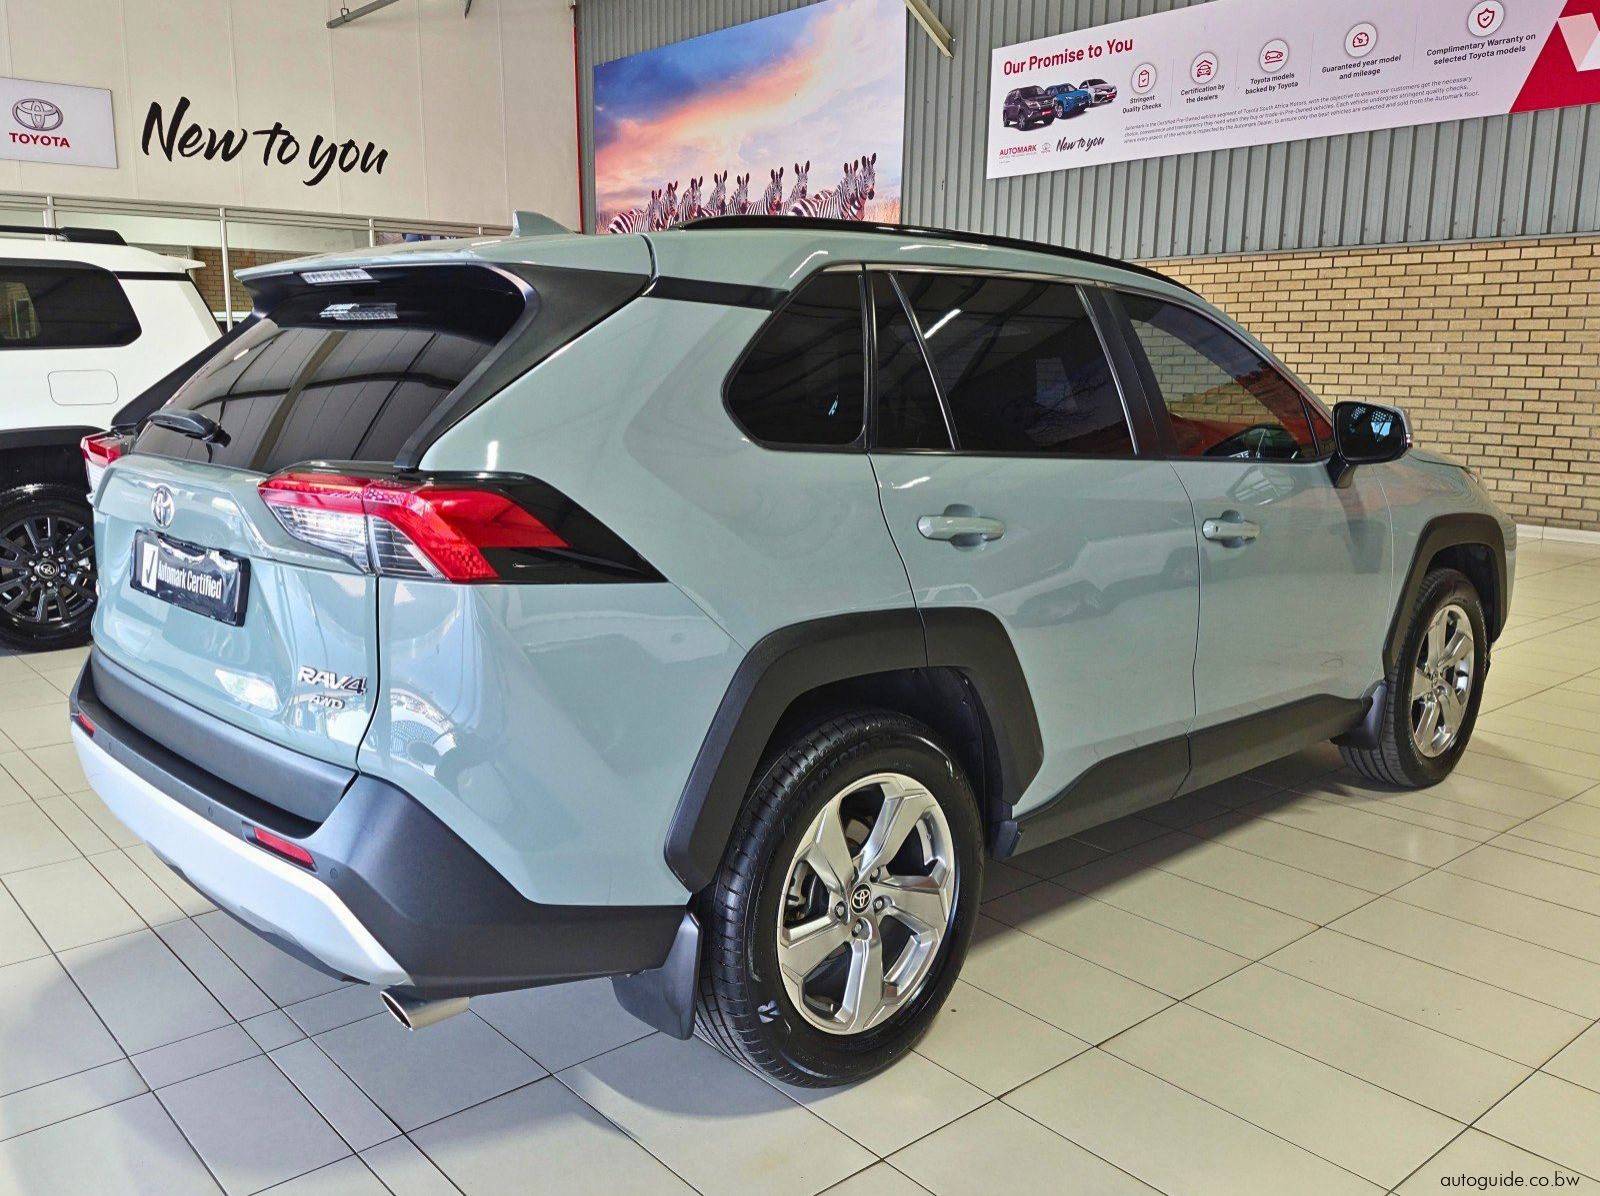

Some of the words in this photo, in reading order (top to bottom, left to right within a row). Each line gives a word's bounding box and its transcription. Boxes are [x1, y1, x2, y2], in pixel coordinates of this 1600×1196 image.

[1426, 42, 1485, 57] Complimentary
[1487, 35, 1524, 47] Warranty
[1004, 60, 1026, 75] Our
[1029, 49, 1084, 71] Promise
[1088, 44, 1102, 58] to
[1107, 39, 1133, 55] You
[1434, 55, 1467, 65] selected
[1469, 50, 1495, 61] Toyota
[1496, 45, 1526, 56] models
[1322, 61, 1360, 73] Guaranteed
[1362, 58, 1377, 68] year
[1379, 54, 1401, 64] model
[1250, 76, 1270, 85] Toyota
[1272, 72, 1294, 82] models
[1339, 72, 1351, 80] and
[1353, 67, 1380, 78] mileage
[1181, 86, 1217, 96] Certification
[1217, 83, 1225, 92] by
[1245, 85, 1267, 95] backed
[1268, 84, 1276, 93] by
[1277, 81, 1298, 90] Toyota
[1130, 95, 1155, 104] Stringent
[1186, 96, 1195, 104] the
[1196, 94, 1218, 102] dealers
[1122, 104, 1141, 114] Quality
[1142, 102, 1162, 111] Checks
[9, 132, 70, 148] TOYOTA
[142, 97, 247, 161] New
[253, 122, 300, 166] to
[302, 134, 388, 186] you
[1056, 137, 1076, 152] New
[1076, 138, 1086, 148] to
[1085, 137, 1104, 151] you
[1000, 144, 1036, 156] AUTOMARK
[157, 560, 186, 589] Automark
[187, 570, 223, 600] Certified
[298, 666, 367, 694] RAV4
[311, 695, 345, 710] AWD
